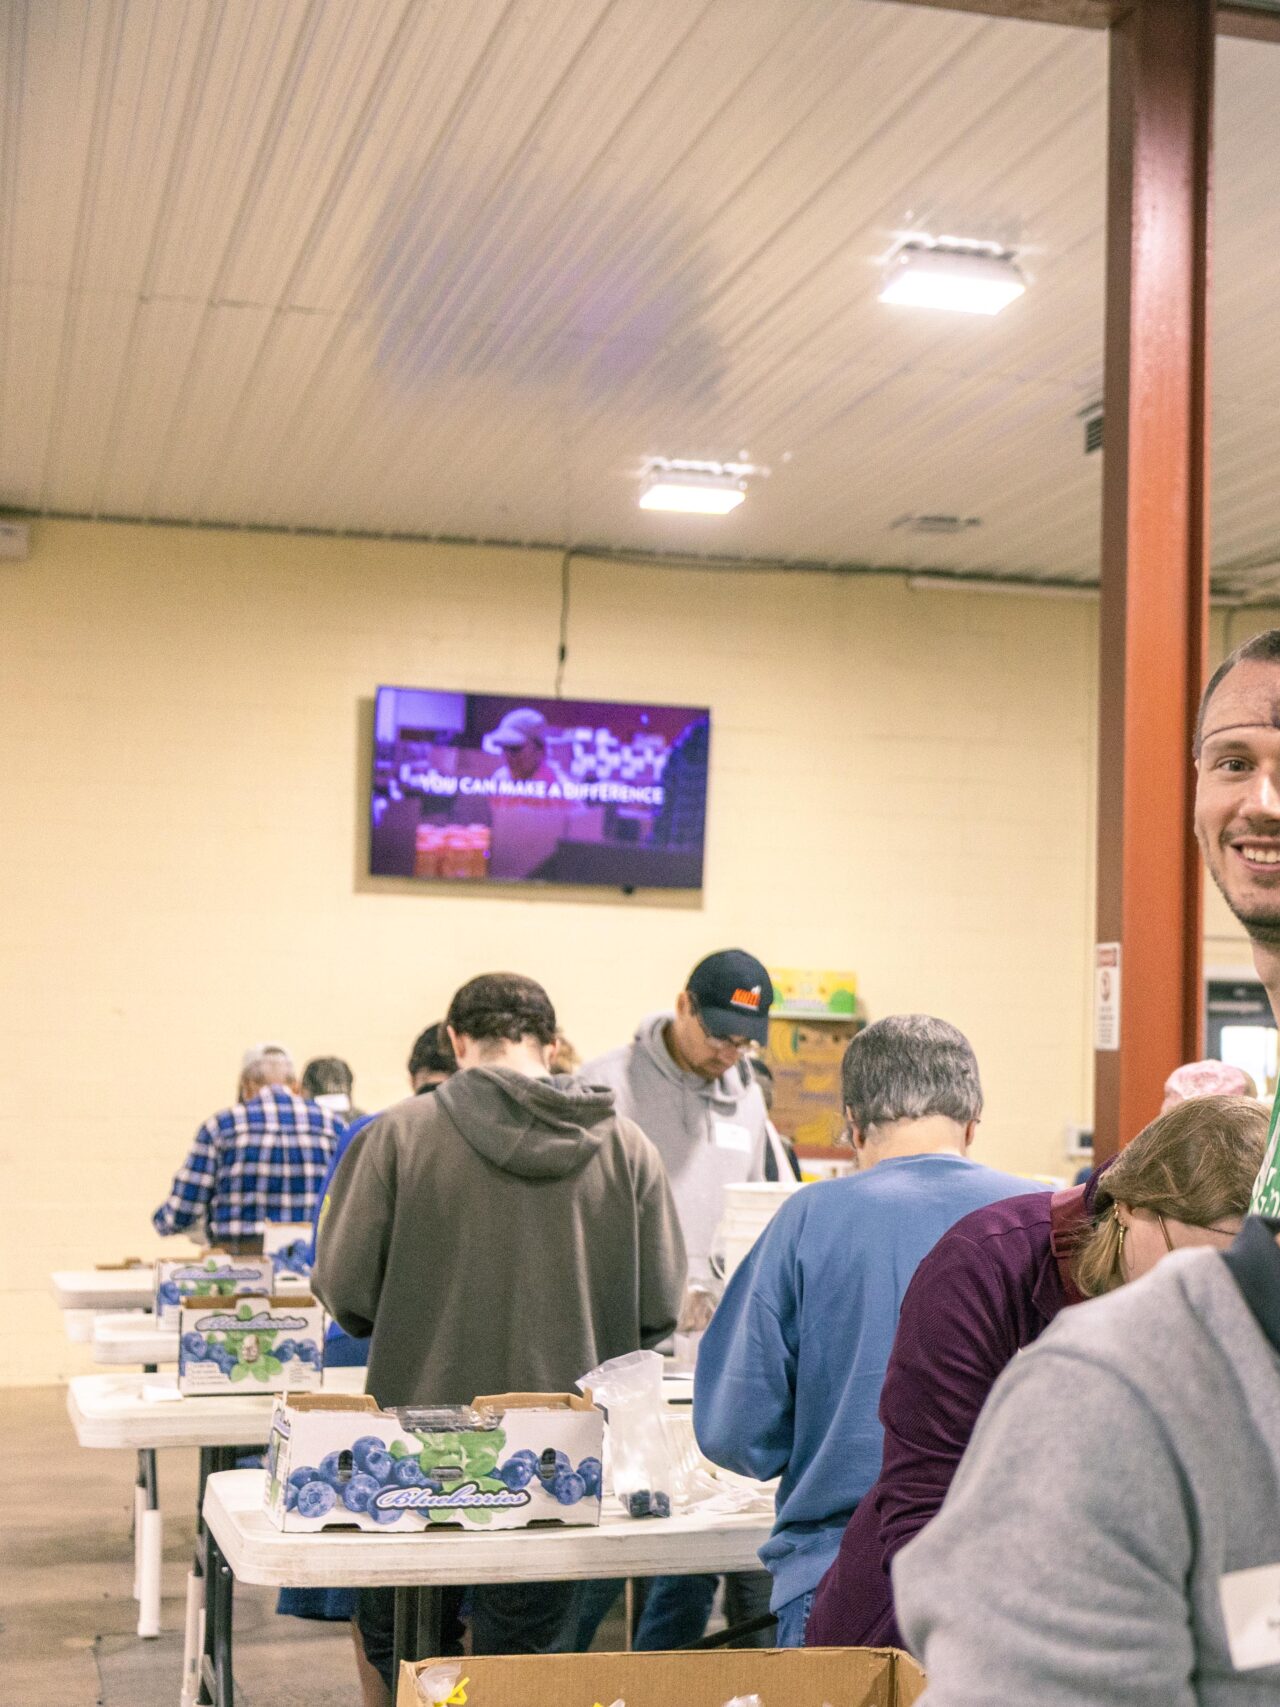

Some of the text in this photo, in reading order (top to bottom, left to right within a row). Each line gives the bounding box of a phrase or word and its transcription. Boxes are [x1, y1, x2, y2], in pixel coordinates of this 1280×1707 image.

[419, 775, 664, 804] YOU CAN MAKE A DIFFERENCE
[376, 1481, 530, 1508] Blueberries
